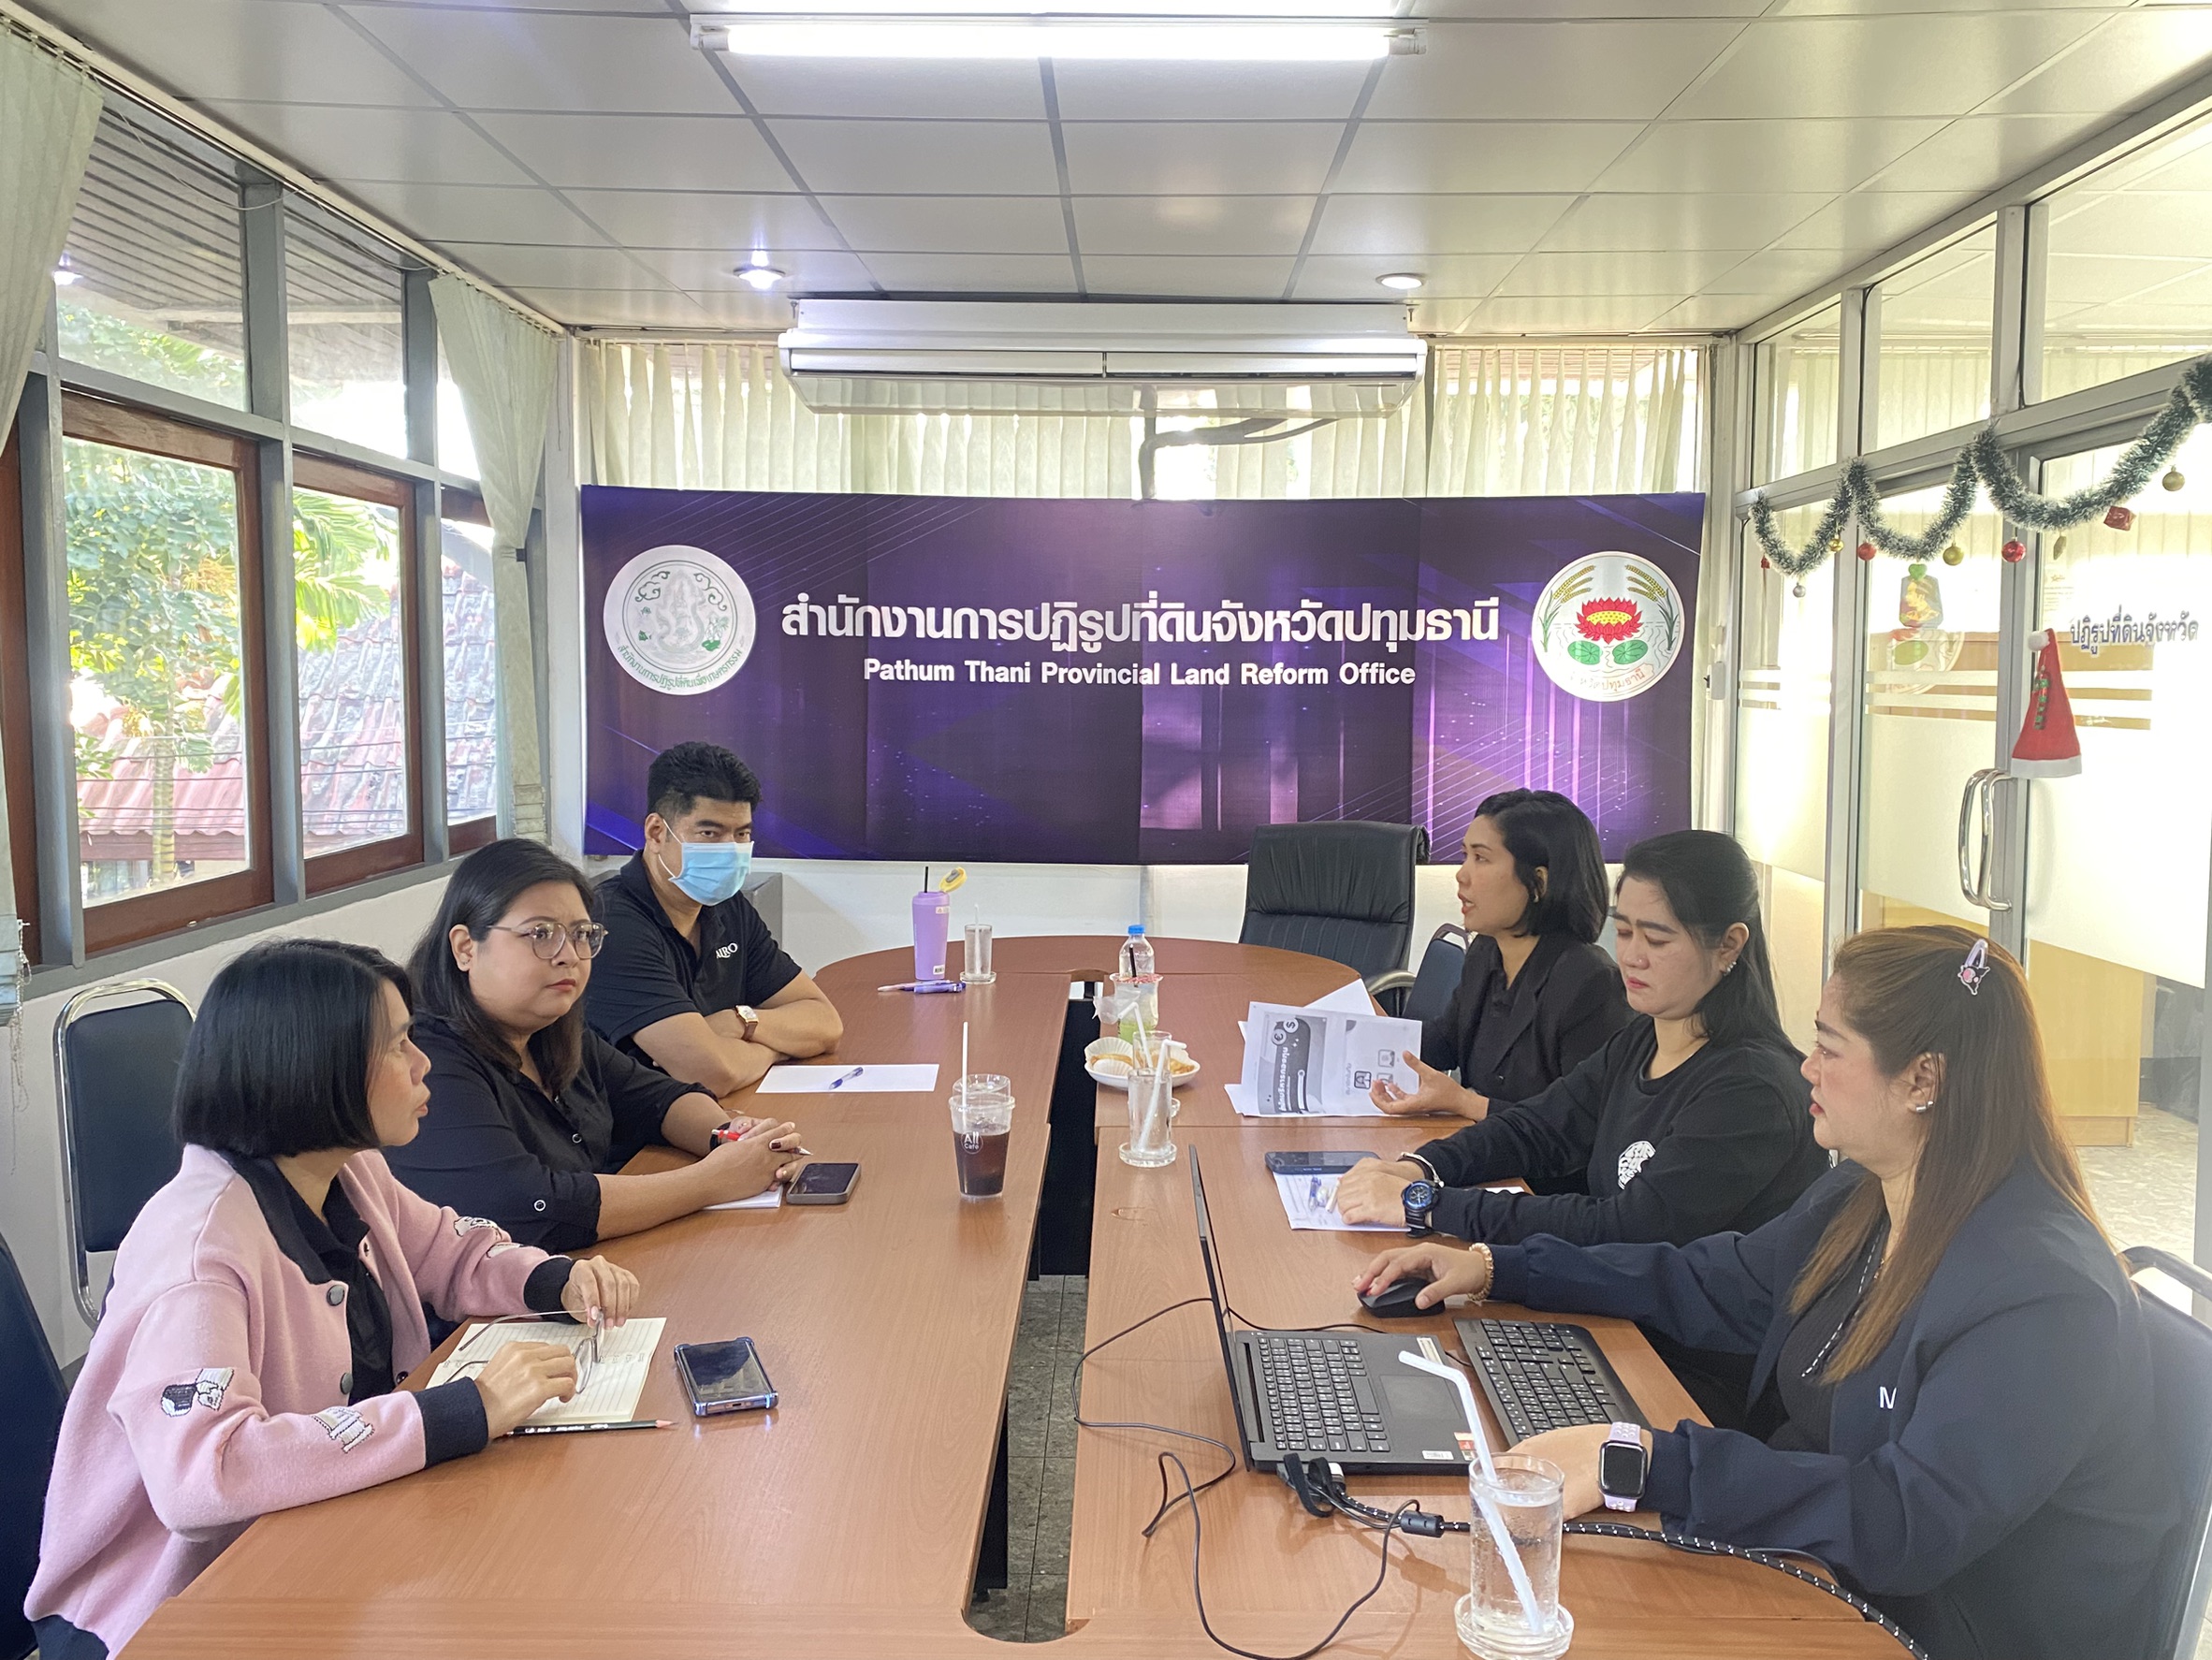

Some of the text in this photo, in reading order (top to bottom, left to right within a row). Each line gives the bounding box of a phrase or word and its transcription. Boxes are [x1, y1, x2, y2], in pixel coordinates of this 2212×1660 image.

[781, 590, 1500, 653] สำนักงานการปฏิรูปที่ดินจังหวัดปทุมธานี
[863, 659, 1417, 686] Pathum Thani Provincial Land Reform Office
[964, 1131, 980, 1144] All
